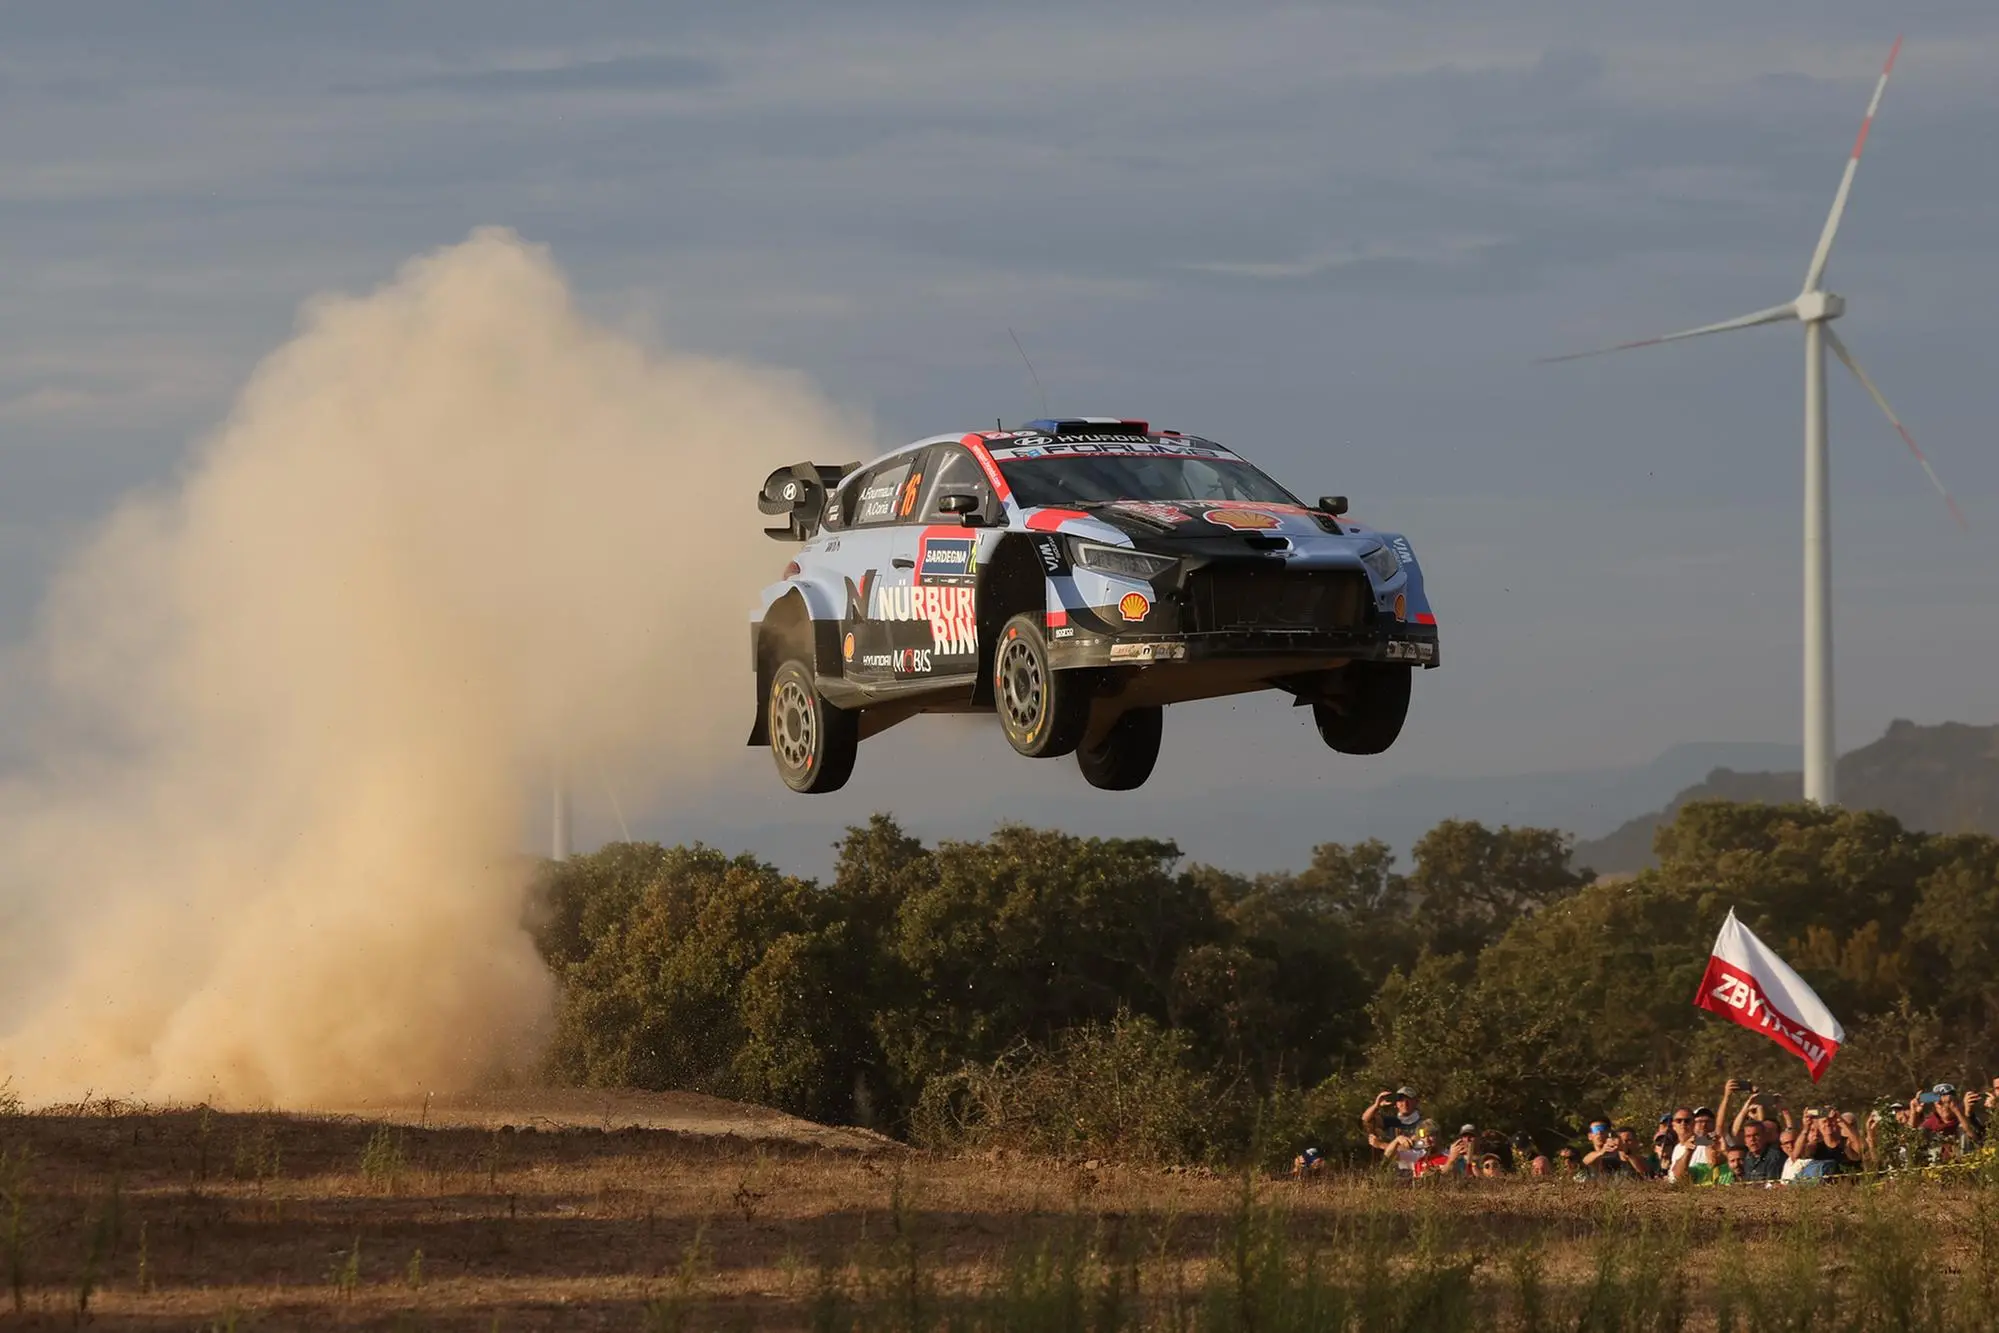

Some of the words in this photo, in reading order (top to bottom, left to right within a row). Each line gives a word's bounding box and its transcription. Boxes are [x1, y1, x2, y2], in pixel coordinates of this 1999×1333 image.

[1057, 433, 1149, 444] HYUNDAI
[900, 473, 922, 516] 16
[925, 550, 967, 564] SARDEGNA
[878, 579, 976, 622] NÜRBUR
[931, 617, 979, 656] RIN
[863, 655, 892, 667] HYUNDAI
[893, 648, 932, 673] MOBIS
